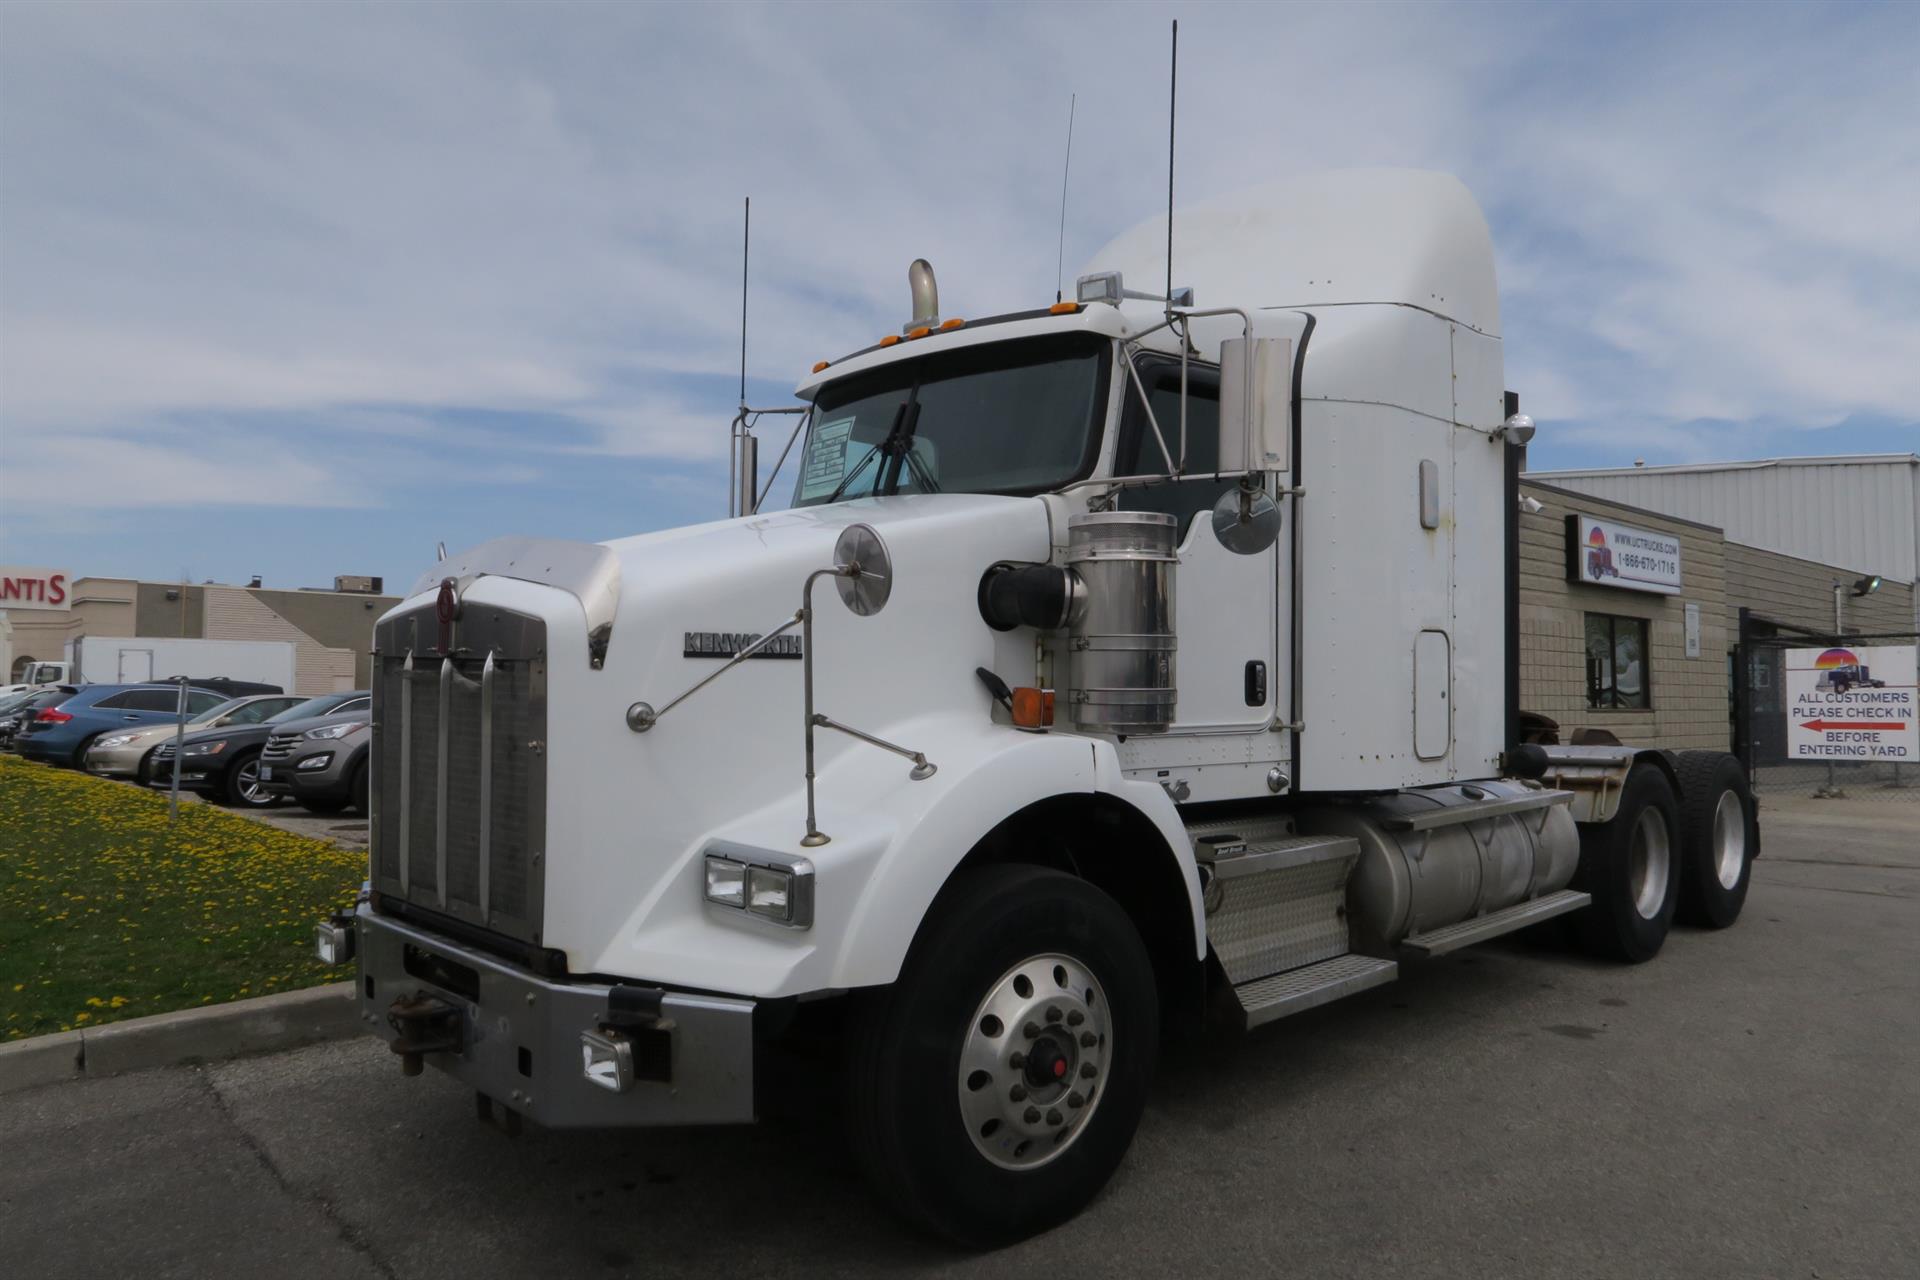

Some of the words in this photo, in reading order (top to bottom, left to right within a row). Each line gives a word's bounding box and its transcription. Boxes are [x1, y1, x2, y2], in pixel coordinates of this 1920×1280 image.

[1614, 533, 1677, 555] WWW.UCTRUCKS.COM
[1618, 552, 1675, 575] 1-866-670-1716
[0, 574, 66, 605] NTIS
[1798, 693, 1823, 703] ALL
[1825, 692, 1910, 703] CUSTOMERS
[1792, 707, 1843, 718] PLEASE
[1846, 707, 1894, 718] CHECK
[1898, 707, 1912, 718] IN
[1826, 732, 1881, 742] BEFORE
[1799, 744, 1866, 756] ENTERING
[1870, 746, 1907, 757] YARD
